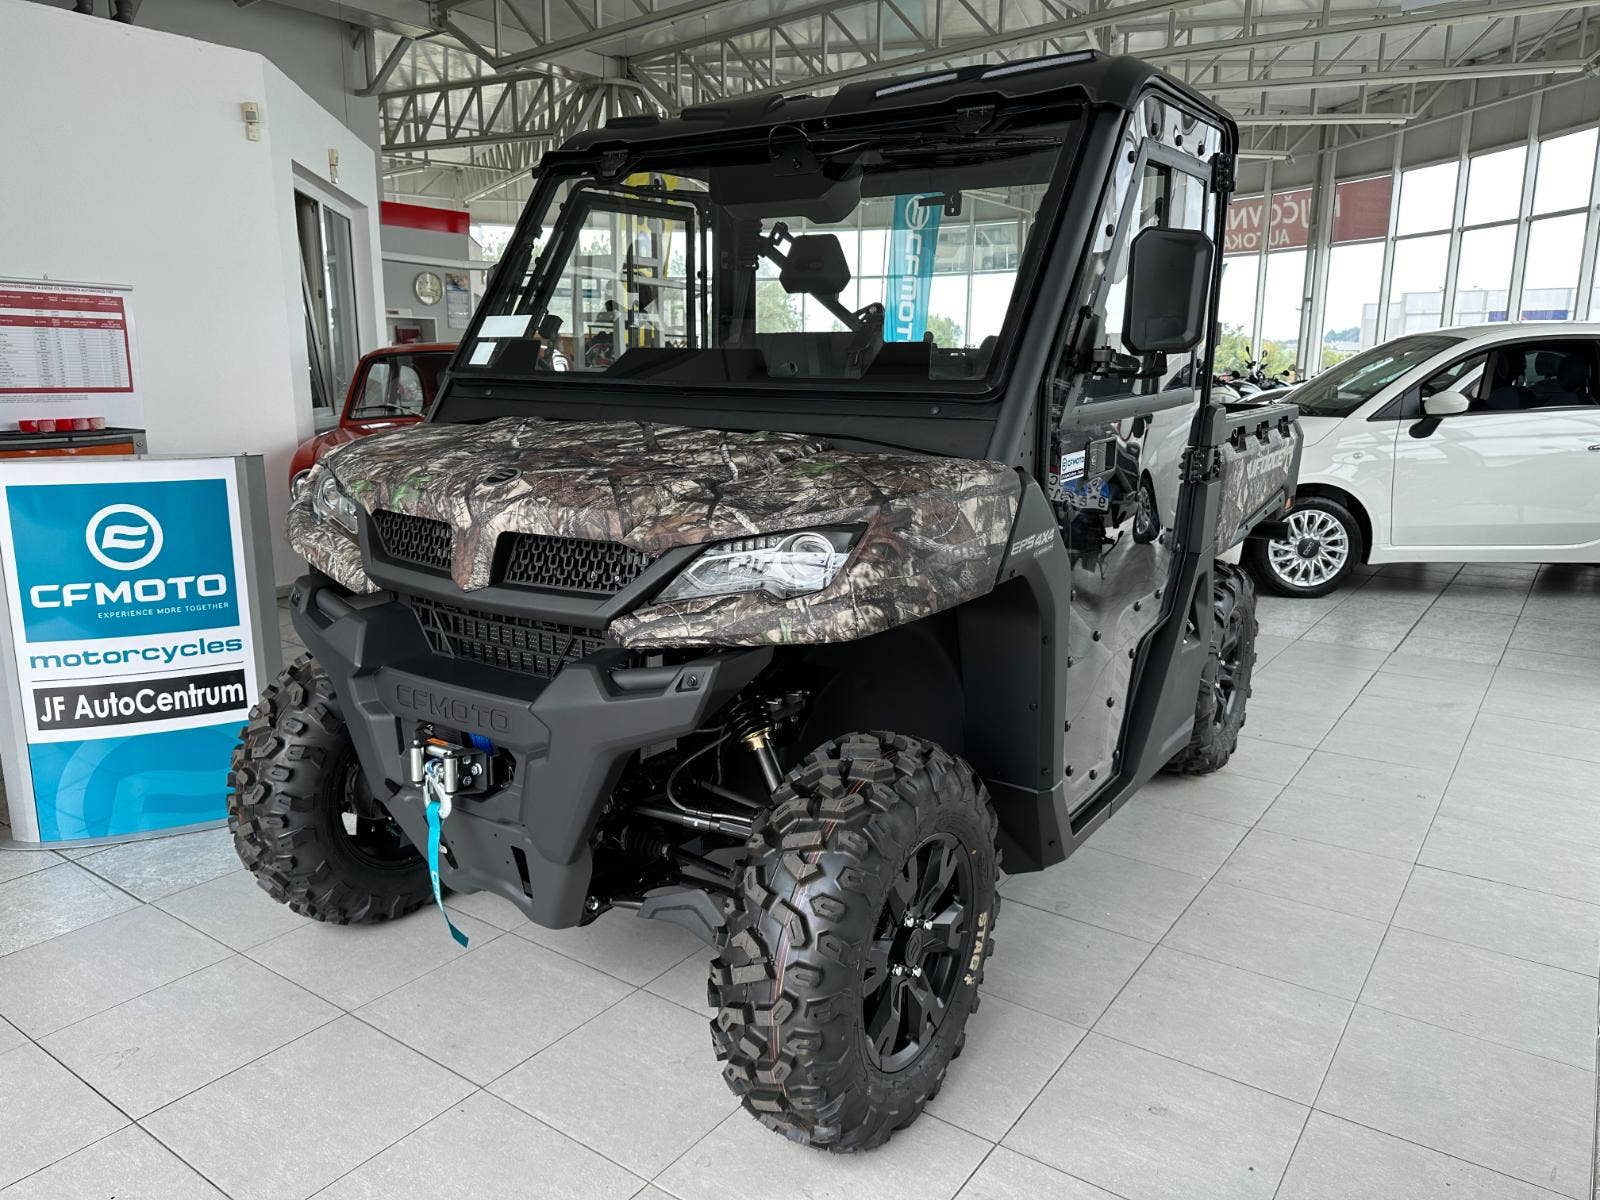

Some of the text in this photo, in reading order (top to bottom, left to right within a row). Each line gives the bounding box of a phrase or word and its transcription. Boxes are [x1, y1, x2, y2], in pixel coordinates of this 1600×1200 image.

[897, 231, 922, 342] CFMOT
[30, 573, 227, 609] CFMOTO
[97, 602, 230, 619] EXPERIENCE MORE TOGETHER
[30, 637, 243, 669] motorcycles
[40, 682, 244, 723] JF AutoCentrum
[396, 683, 512, 733] CFMOTO
[969, 912, 988, 972] STAG
